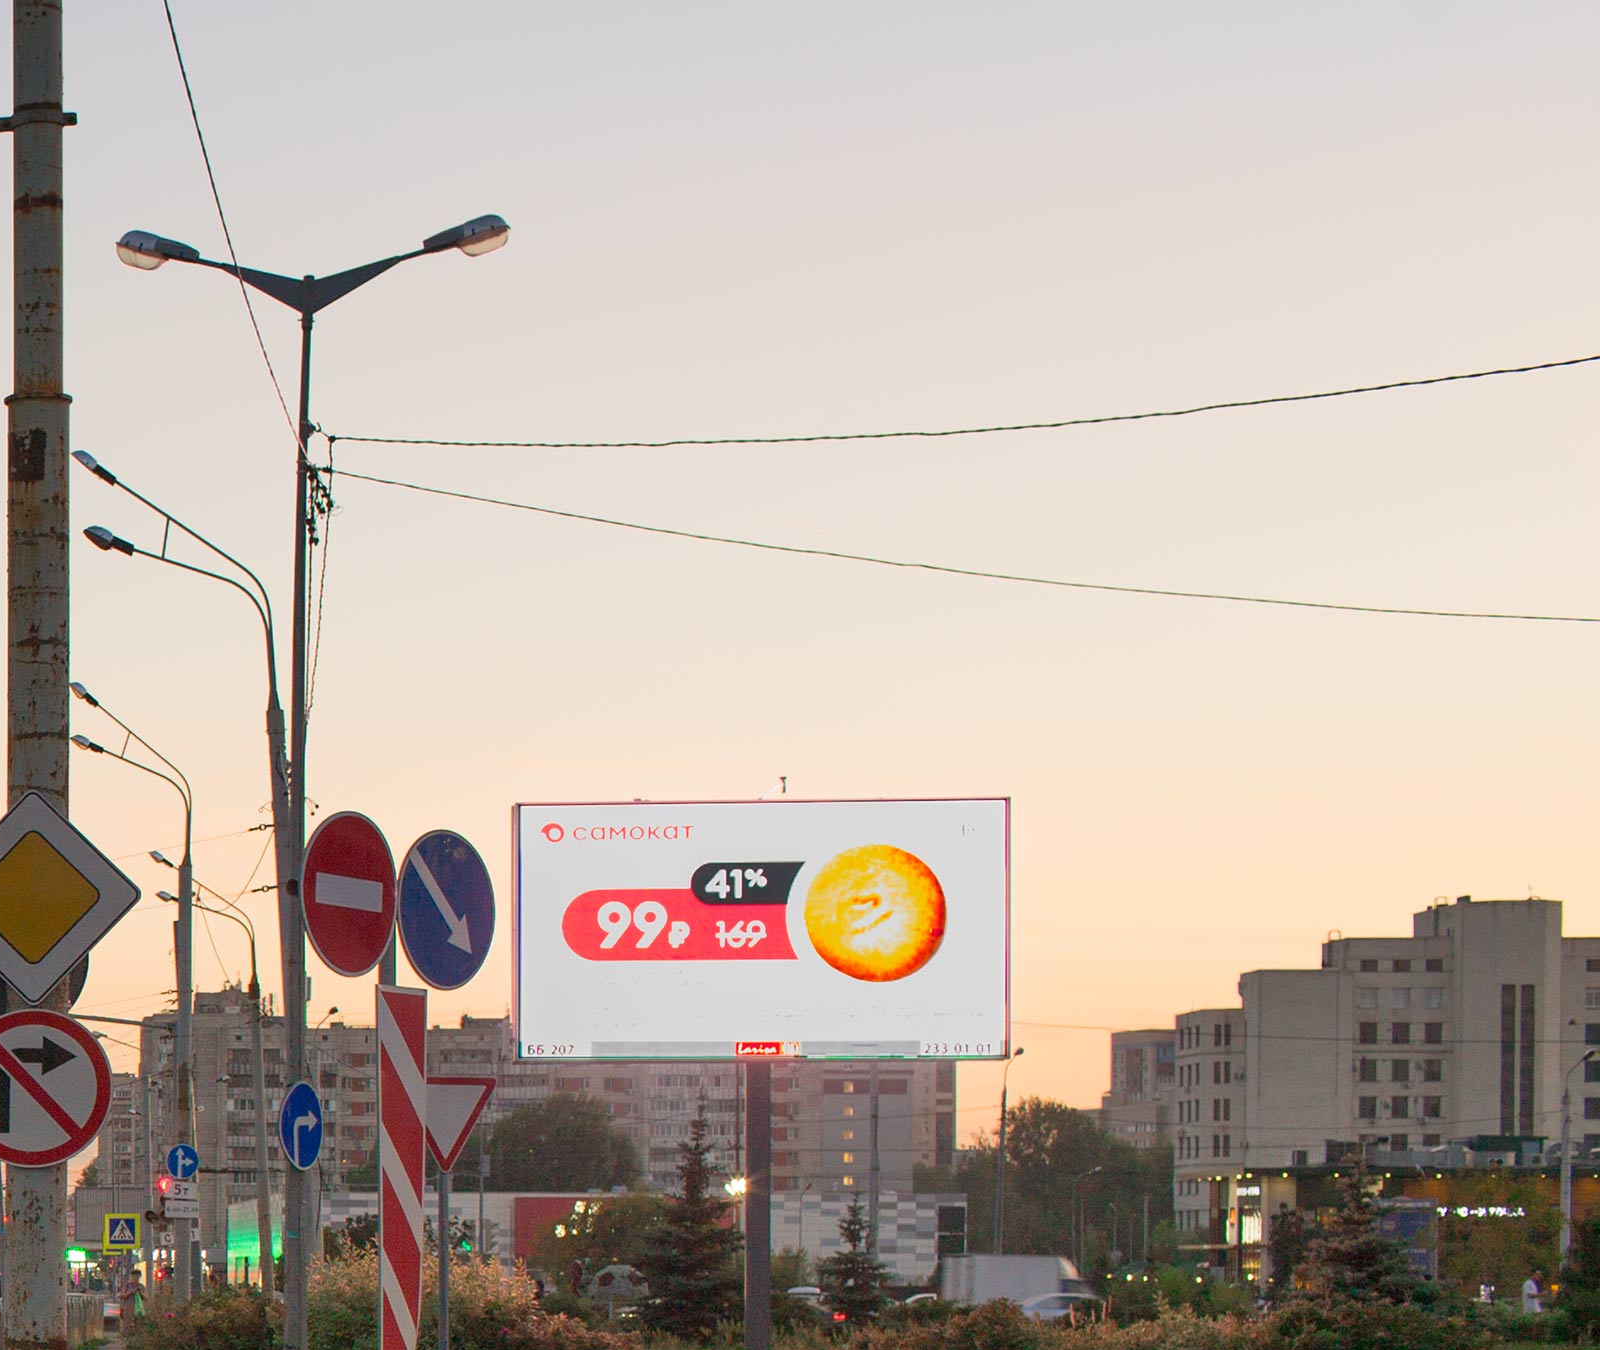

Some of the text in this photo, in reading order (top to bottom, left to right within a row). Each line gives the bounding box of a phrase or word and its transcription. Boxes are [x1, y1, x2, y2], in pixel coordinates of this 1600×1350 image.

[704, 867, 768, 899] 41%
[551, 1044, 575, 1055] 207
[924, 1043, 991, 1054] 233 01 01
